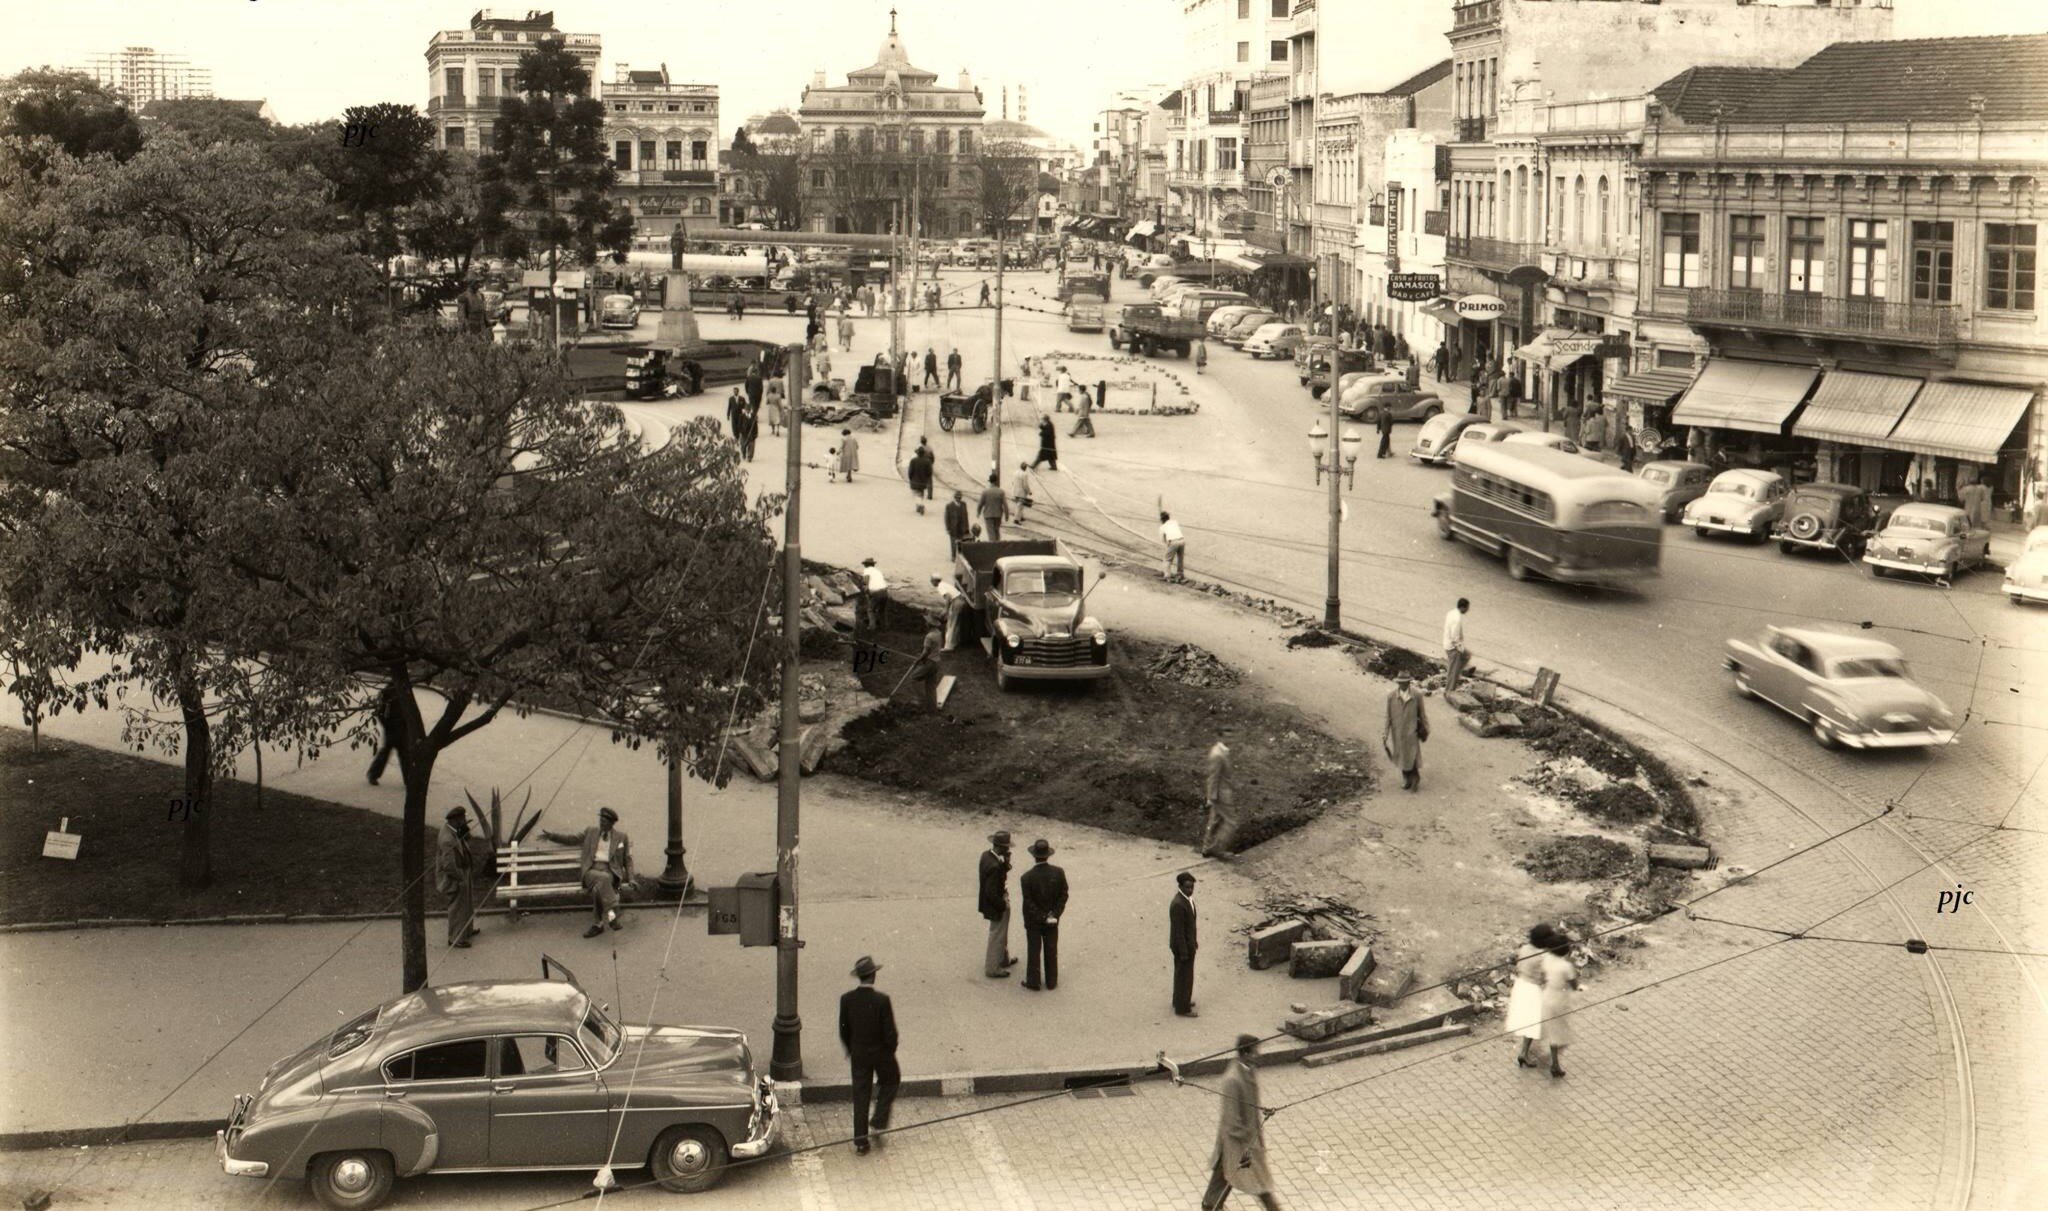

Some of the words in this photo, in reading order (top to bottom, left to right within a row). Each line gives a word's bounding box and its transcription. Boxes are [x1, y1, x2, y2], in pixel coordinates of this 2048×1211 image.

[1392, 281, 1435, 289] DAMASCO
[1391, 290, 1408, 298] BAR
[1458, 302, 1506, 313] PRIMOR
